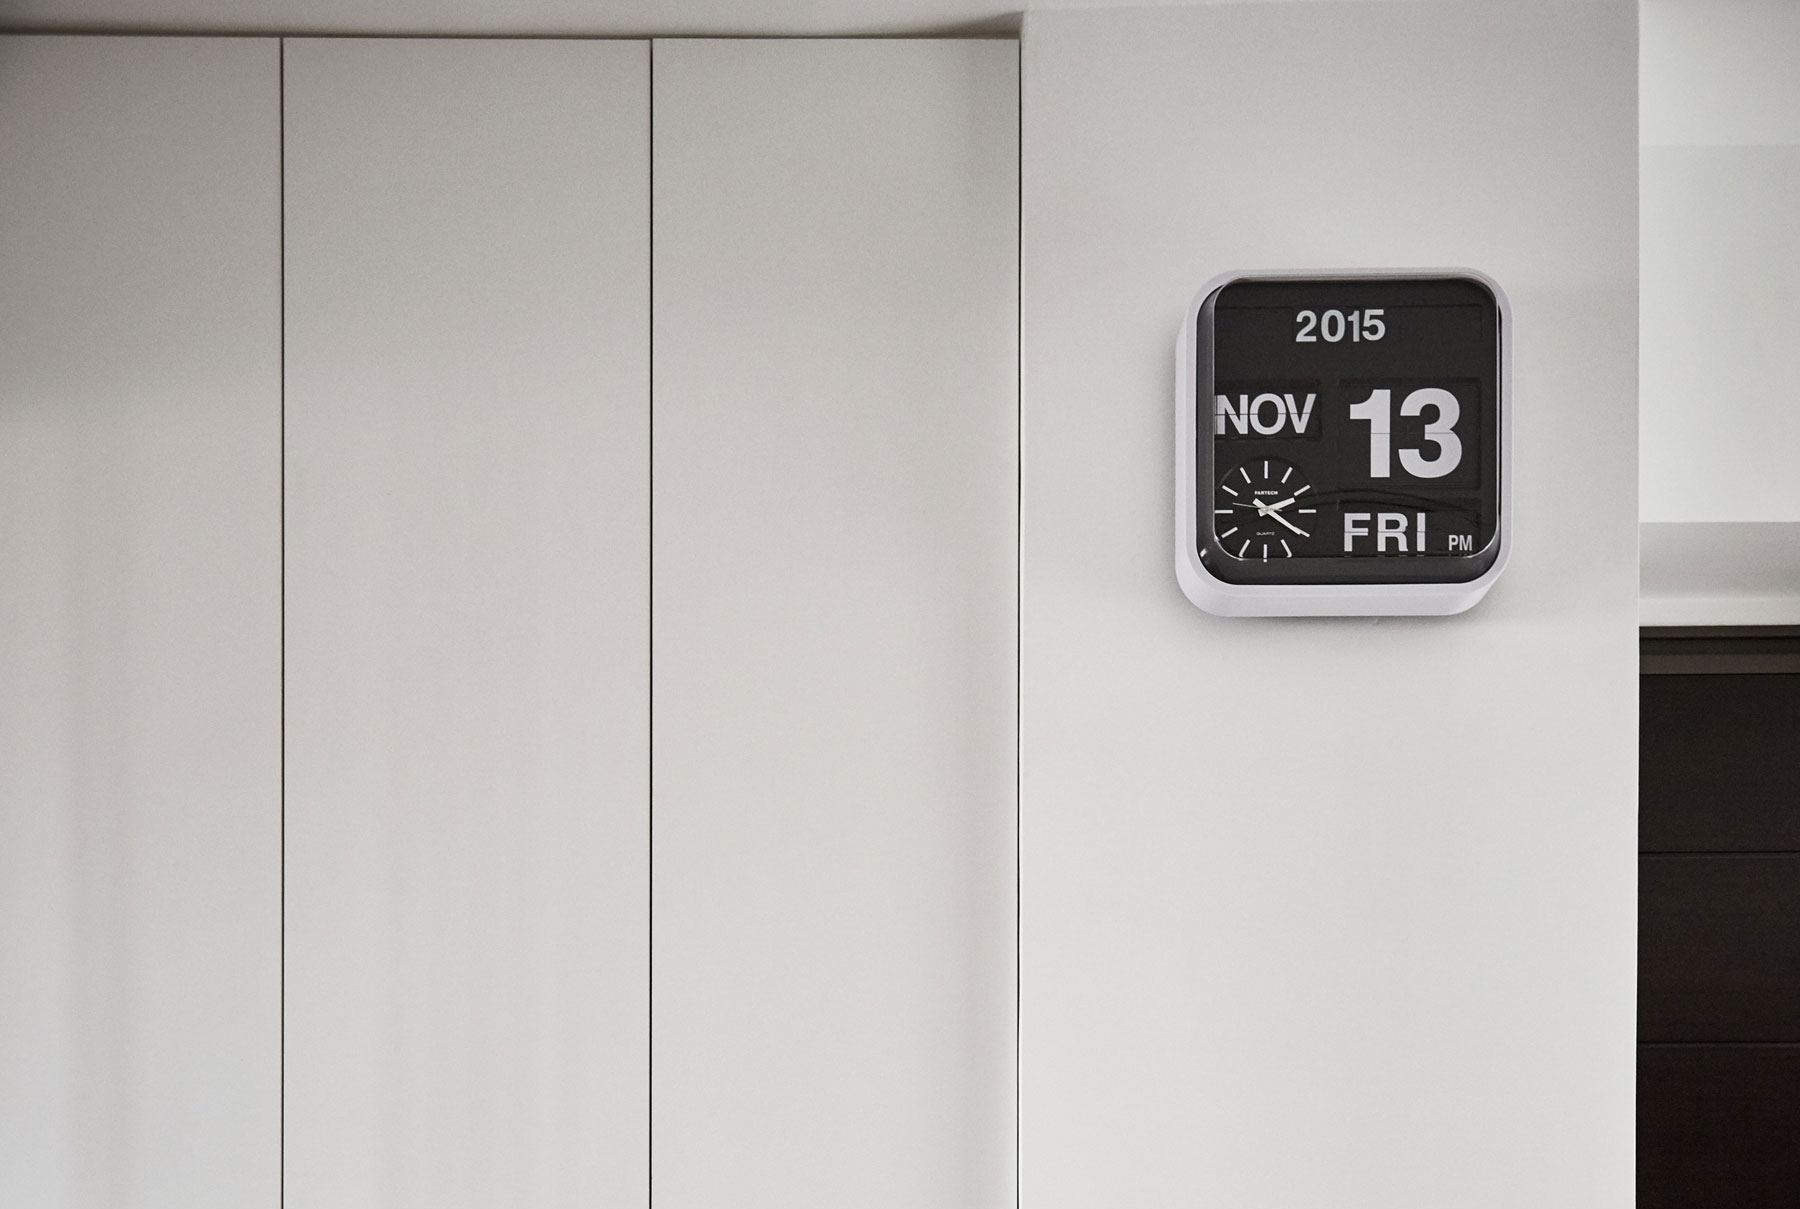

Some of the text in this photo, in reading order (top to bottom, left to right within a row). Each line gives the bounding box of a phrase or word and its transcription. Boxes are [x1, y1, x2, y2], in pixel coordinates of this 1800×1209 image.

[1295, 309, 1386, 343] 2015
[1215, 388, 1462, 478] NOV 13
[1344, 512, 1473, 552] FRI PM
